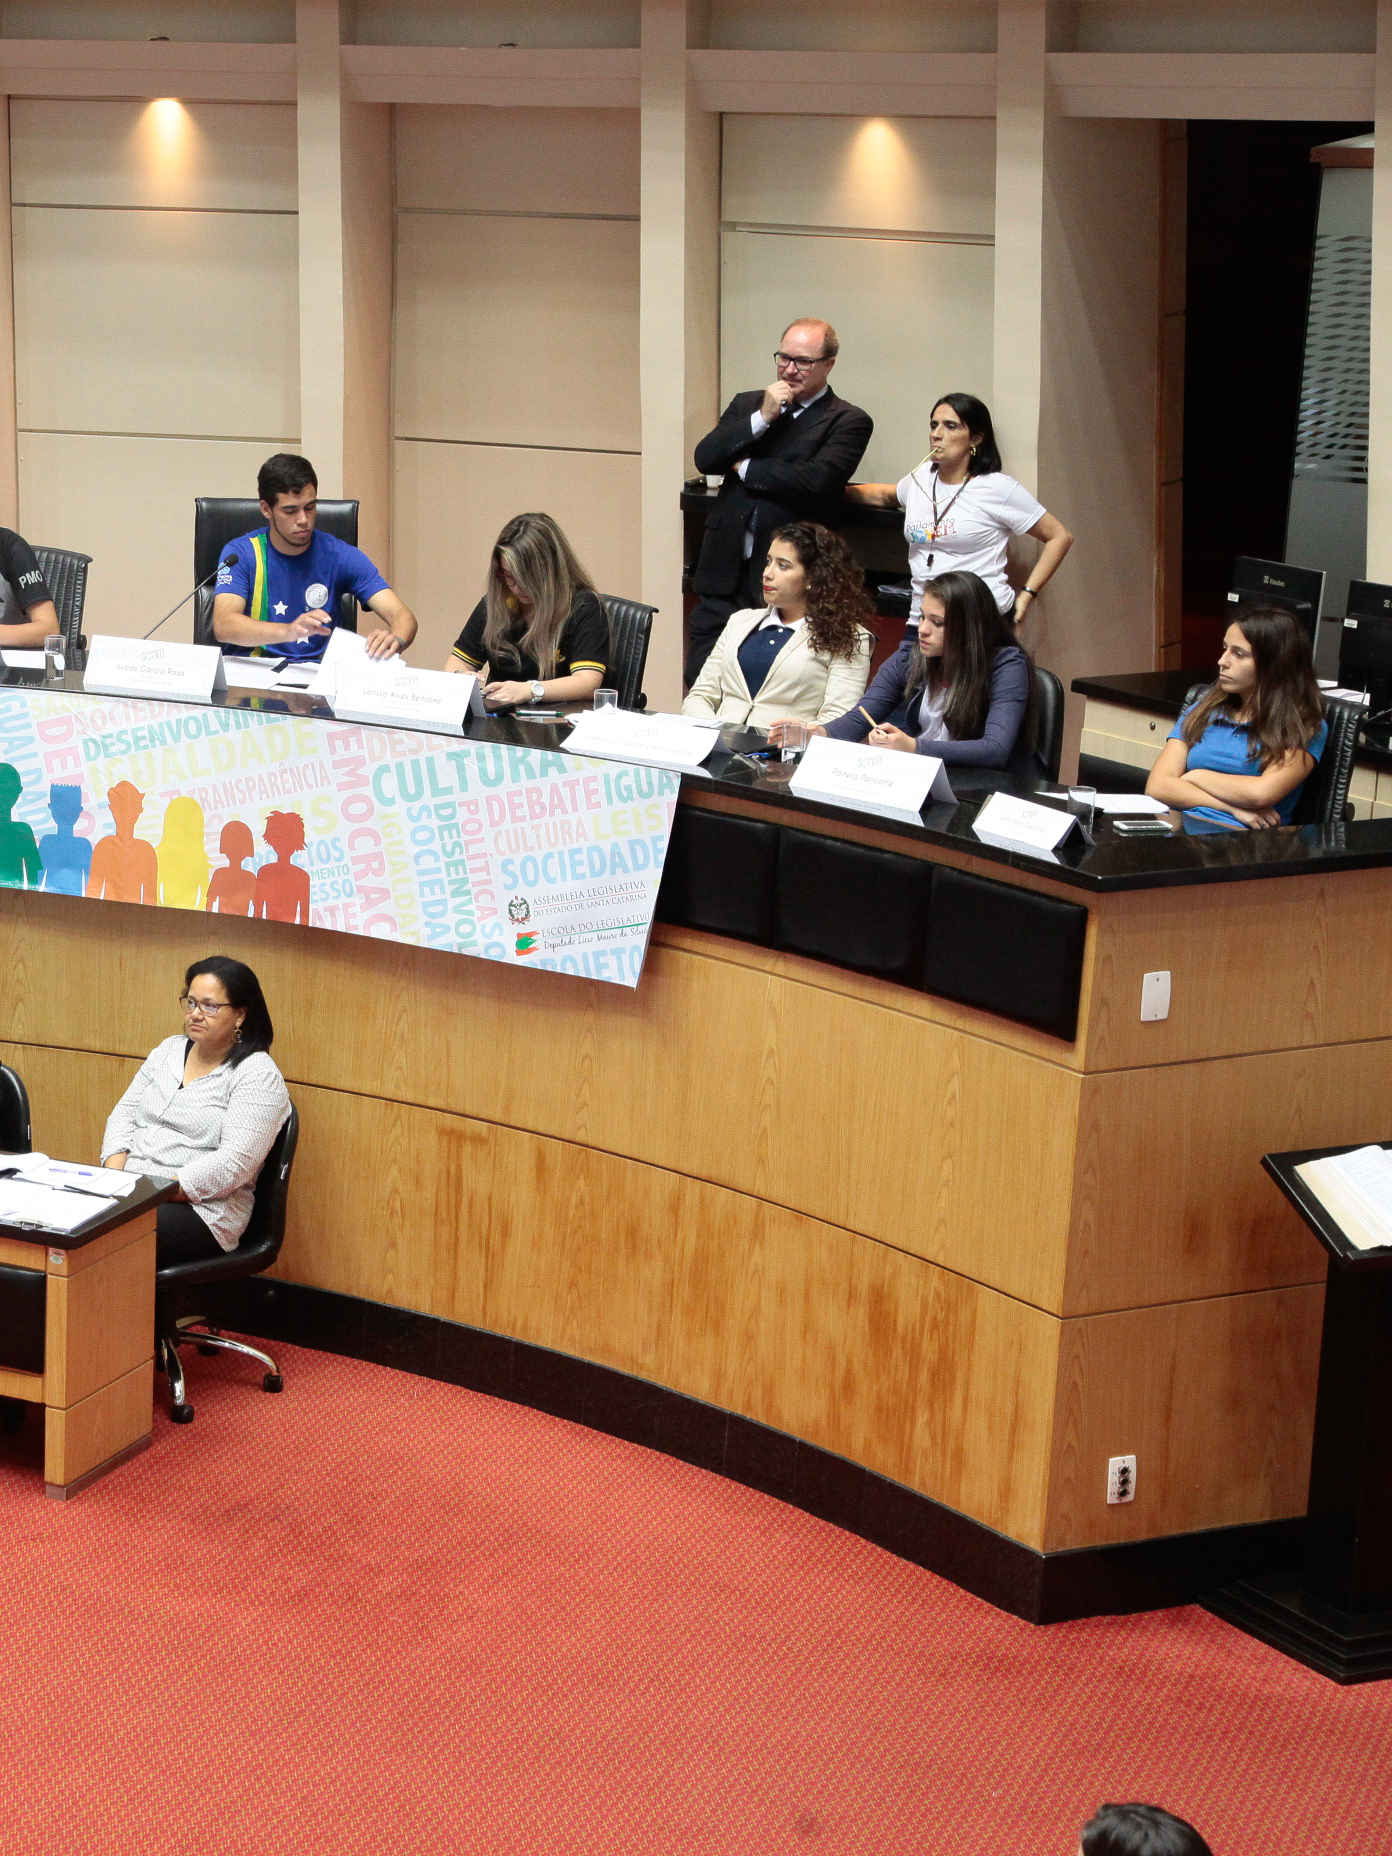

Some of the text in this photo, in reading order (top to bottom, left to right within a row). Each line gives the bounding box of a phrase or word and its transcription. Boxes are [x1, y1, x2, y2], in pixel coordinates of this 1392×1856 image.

[117, 663, 138, 672] Lucas
[168, 668, 185, 677] Rosa
[363, 687, 388, 698] Larissa
[390, 691, 409, 700] Alves
[485, 774, 602, 828] DEBATE
[591, 803, 665, 842] LEIS
[493, 815, 590, 857] CULTURA
[500, 834, 665, 891] SOCIEDADE
[587, 880, 647, 899] LEGISLATIVA
[533, 909, 545, 917] DO
[546, 905, 574, 916] ESTADO
[587, 900, 611, 909] SANTA
[612, 893, 648, 905] CATARINA
[542, 912, 650, 938] ESCOLA DO LEGISLATIVO
[543, 935, 576, 953] Deputado
[619, 928, 629, 938] da
